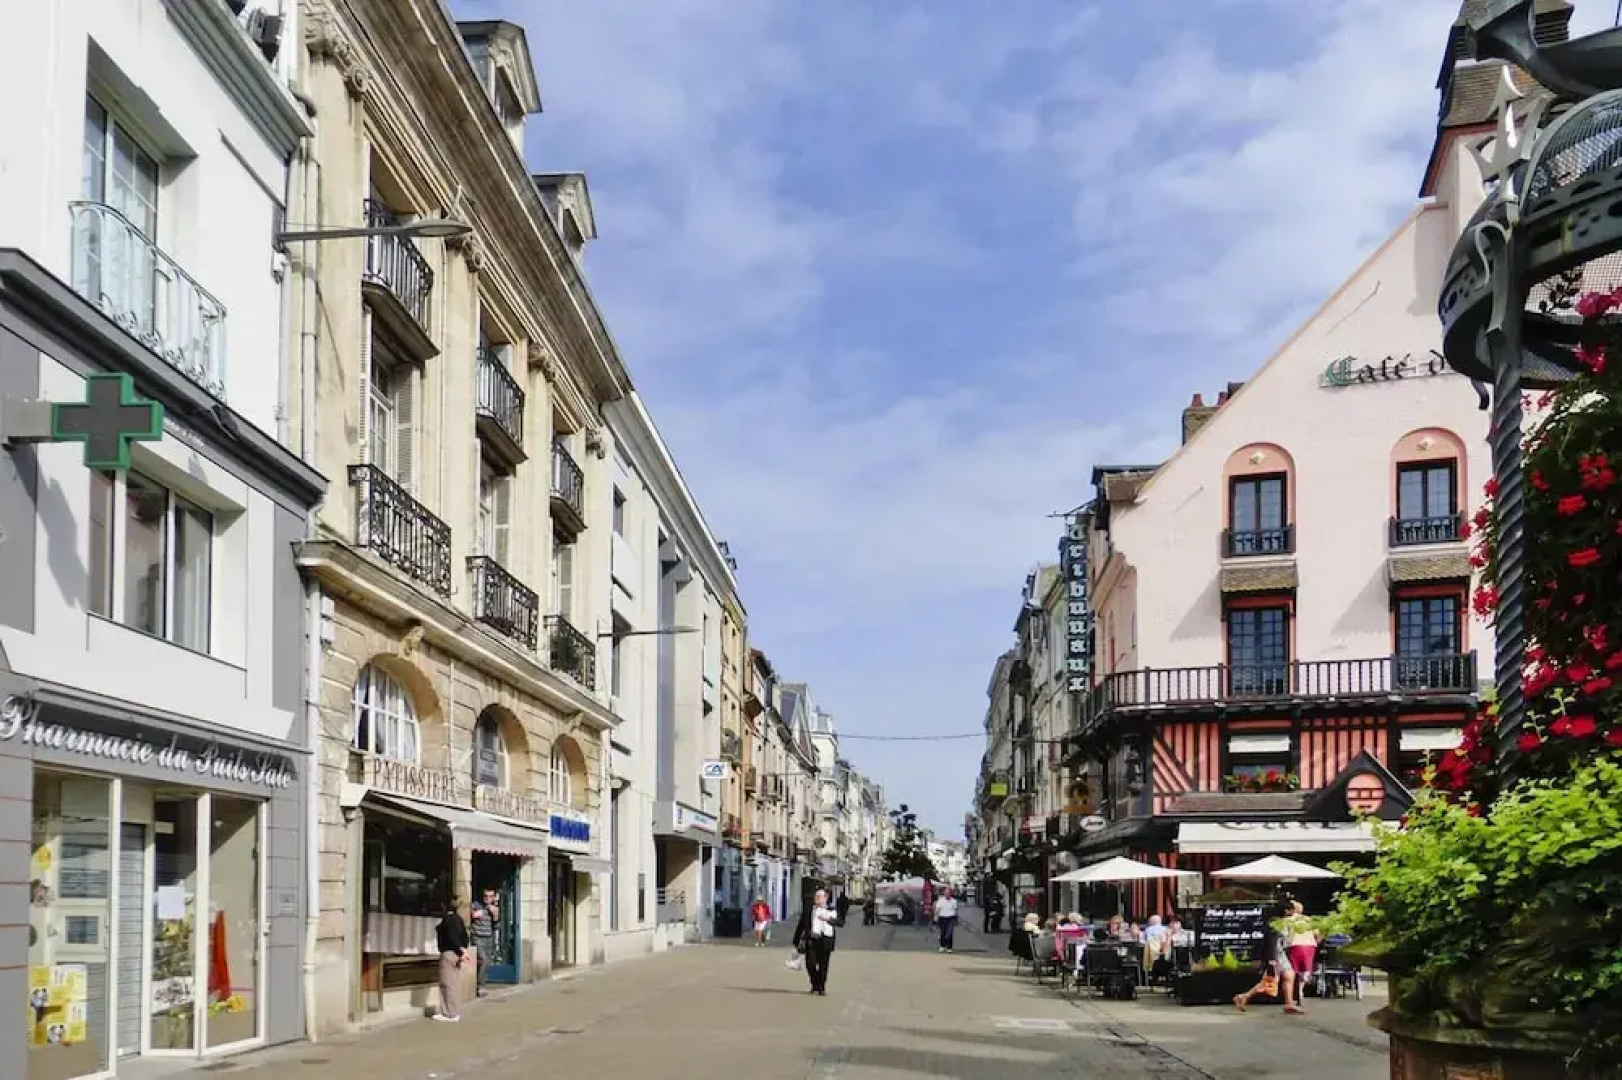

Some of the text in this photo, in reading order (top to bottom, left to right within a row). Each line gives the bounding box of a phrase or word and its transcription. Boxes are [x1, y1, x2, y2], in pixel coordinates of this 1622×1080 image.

[1324, 352, 1412, 387] Café
[0, 695, 154, 763] Pharmacie
[158, 733, 189, 770] du
